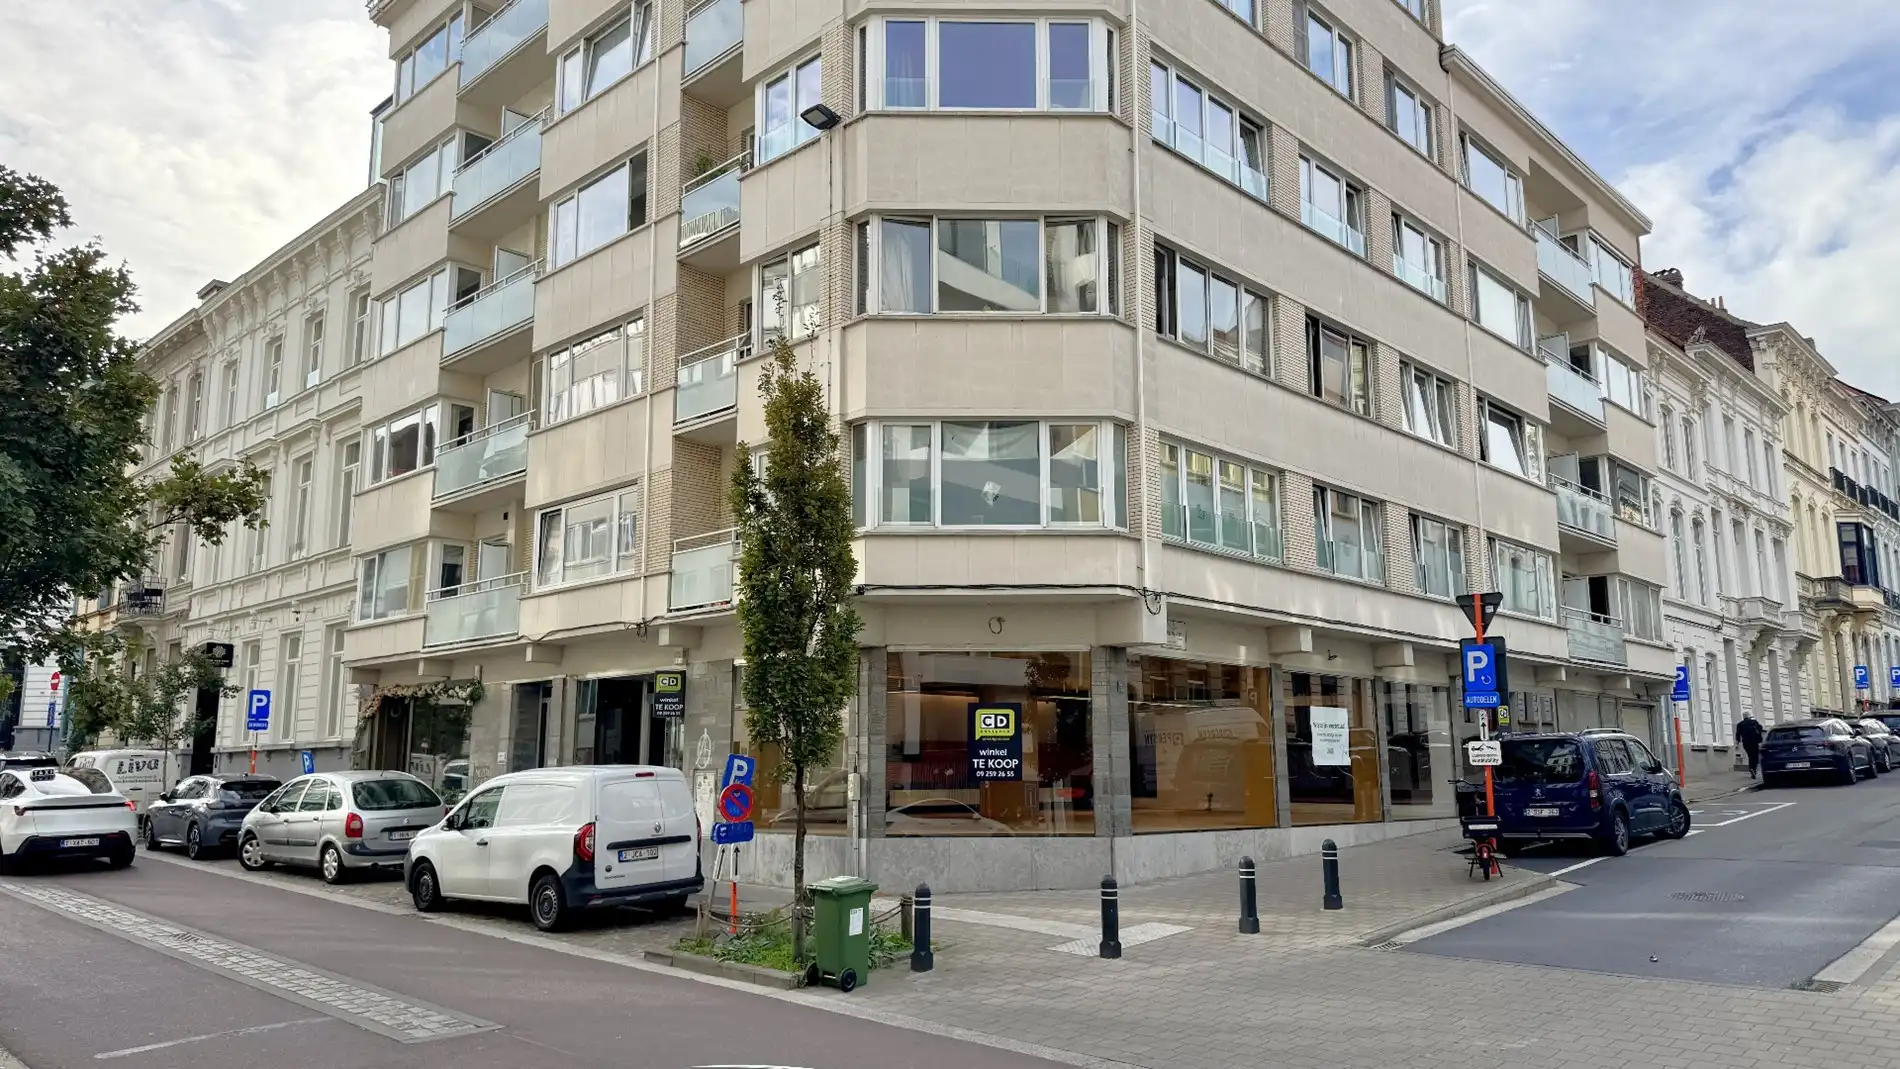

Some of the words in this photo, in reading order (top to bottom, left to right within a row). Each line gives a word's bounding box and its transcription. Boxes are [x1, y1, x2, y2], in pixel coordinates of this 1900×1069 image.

[1467, 650, 1488, 682] P
[1855, 668, 1866, 681] P
[251, 694, 268, 715] P
[1465, 695, 1498, 704] AUTODELEN
[655, 703, 663, 711] TE
[664, 703, 684, 711] KOOP
[982, 715, 1008, 728] CD
[979, 748, 1008, 756] winkel
[303, 754, 310, 772] P
[972, 759, 985, 769] TE
[988, 759, 1019, 769] KOOP
[33, 769, 54, 777] TAXI
[729, 758, 748, 786] P
